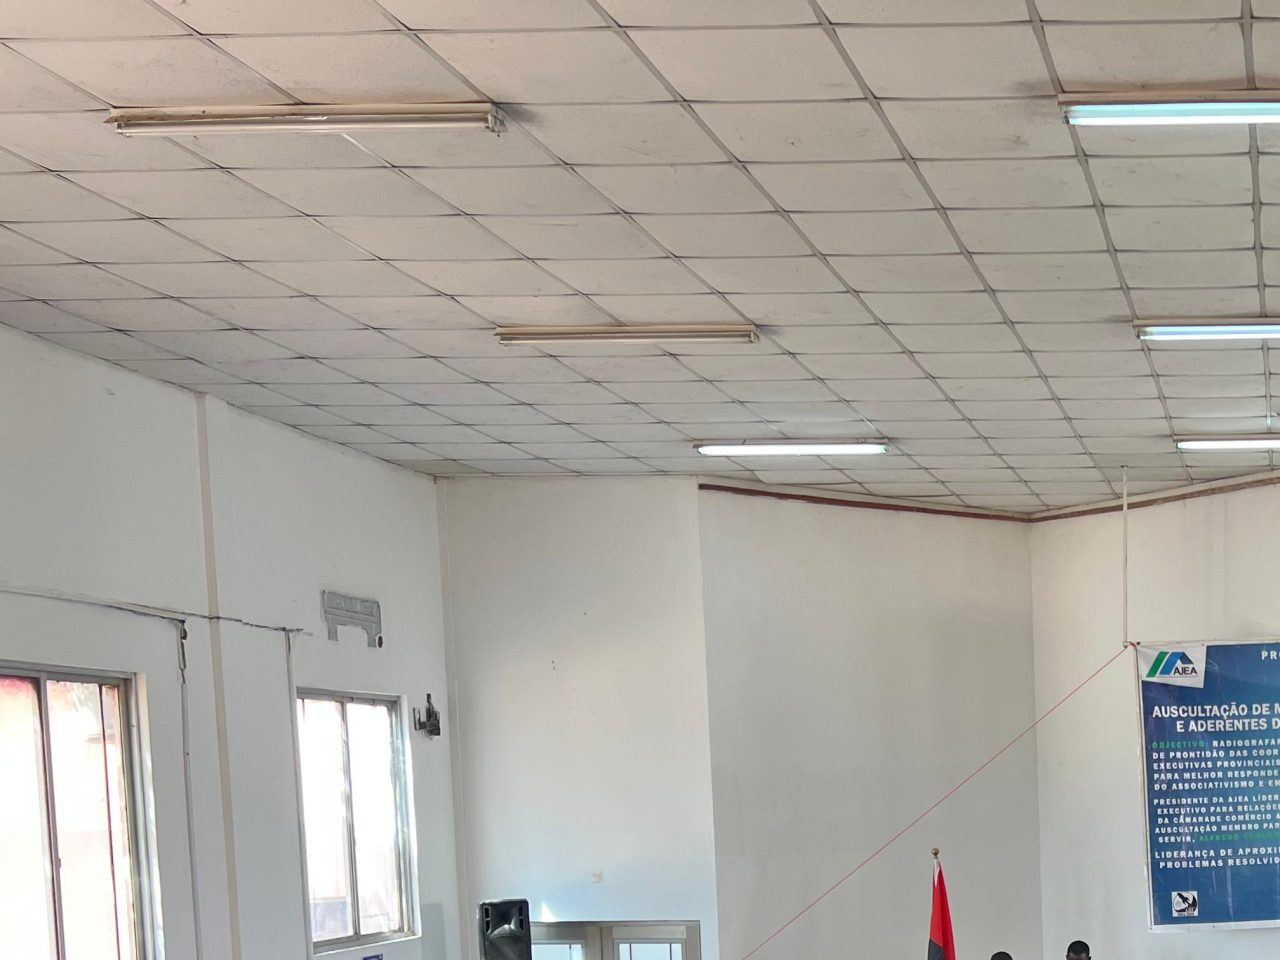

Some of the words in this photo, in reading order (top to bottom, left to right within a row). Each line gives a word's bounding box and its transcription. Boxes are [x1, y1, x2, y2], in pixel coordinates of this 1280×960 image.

[1173, 666, 1198, 675] AJEA
[1152, 702, 1248, 719] AUSCULTAÇÃO
[1252, 703, 1270, 716] DE
[1176, 720, 1184, 732] E
[1188, 718, 1268, 732] ADERENTES
[1170, 750, 1224, 759] PRONTIDÃO
[1153, 761, 1212, 770] EXECUTIVAS
[1216, 760, 1280, 768] PROVINCIAIS
[1154, 772, 1179, 780] PARA
[1183, 771, 1223, 780] MELHOR
[1172, 780, 1254, 790] ASSOCIATIVISMO
[1153, 797, 1208, 806] PRESIDENTE
[1252, 794, 1279, 802] LÍDER
[1157, 806, 1206, 814] EXECUTIVO
[1154, 824, 1218, 834] AUSCULTAÇÃO
[1221, 823, 1259, 832] MEMBRO
[1158, 836, 1195, 844] SERVIR,
[1154, 850, 1216, 859] LIDERANÇA
[1160, 860, 1224, 868] PROBLEMAS
